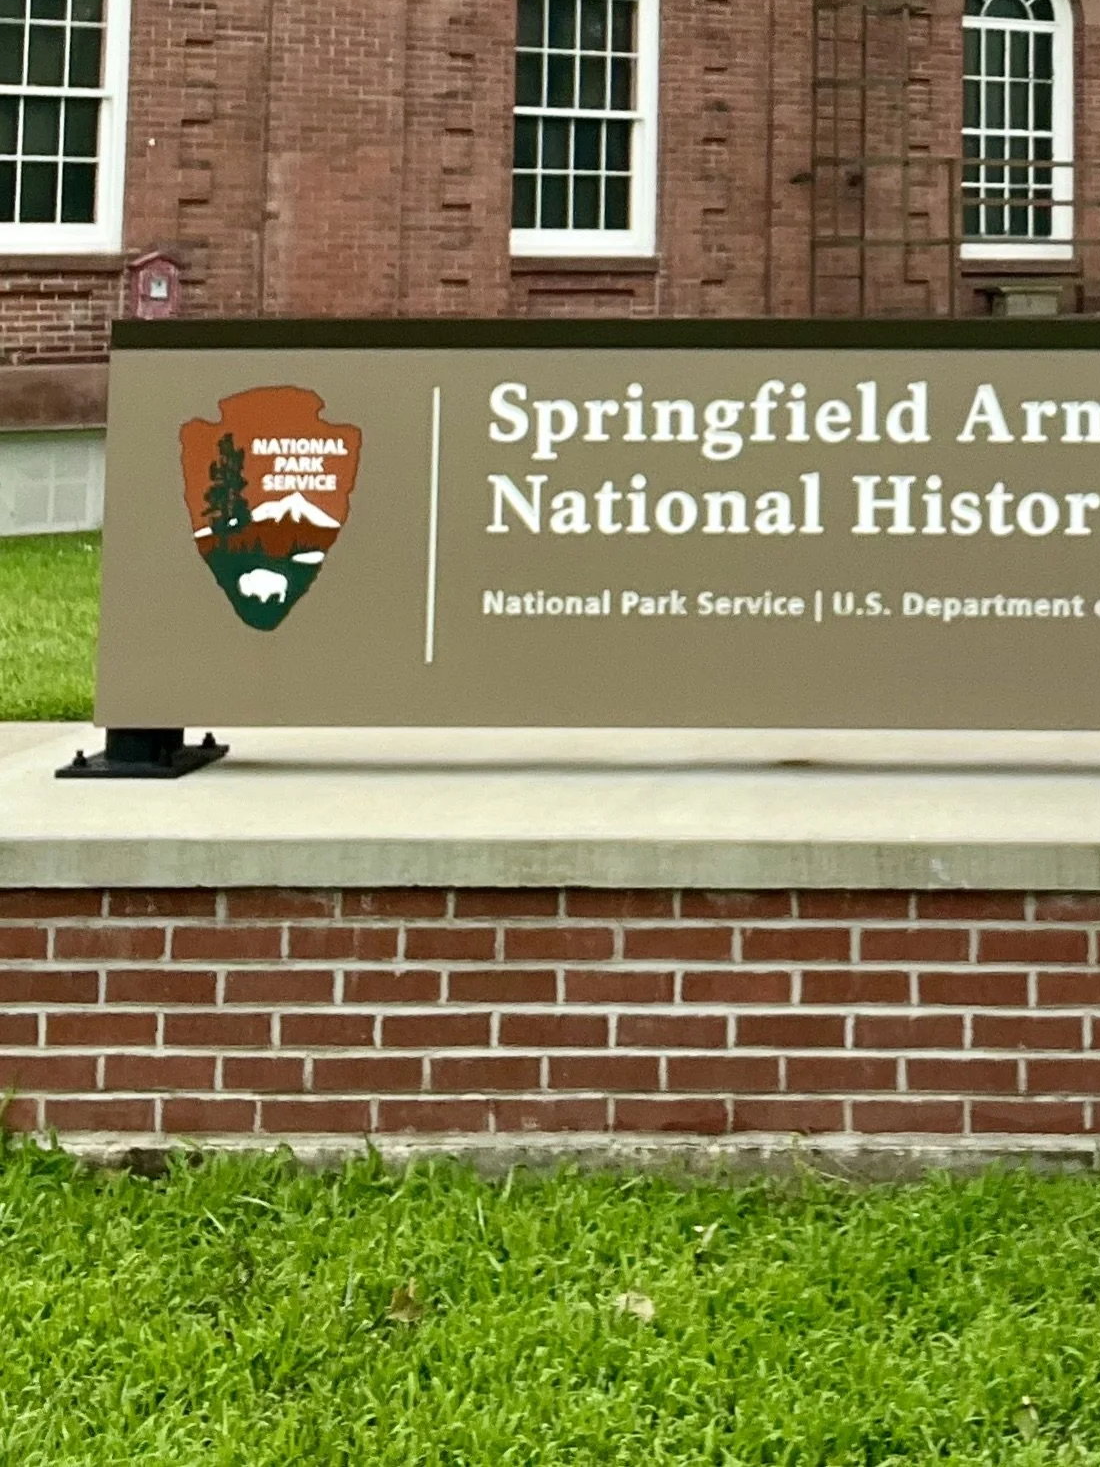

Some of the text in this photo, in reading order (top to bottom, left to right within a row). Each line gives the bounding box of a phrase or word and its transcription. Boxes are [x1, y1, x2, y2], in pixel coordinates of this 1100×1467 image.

[488, 379, 932, 461] Springfield
[252, 438, 348, 456] NATIONAL
[273, 456, 324, 473] PARK
[262, 474, 337, 492] SERVICE
[486, 471, 825, 535] National
[482, 589, 611, 615] National
[621, 589, 687, 616] Park
[697, 591, 806, 616] Service
[832, 591, 891, 616] U.S.
[902, 592, 1085, 622] Department
